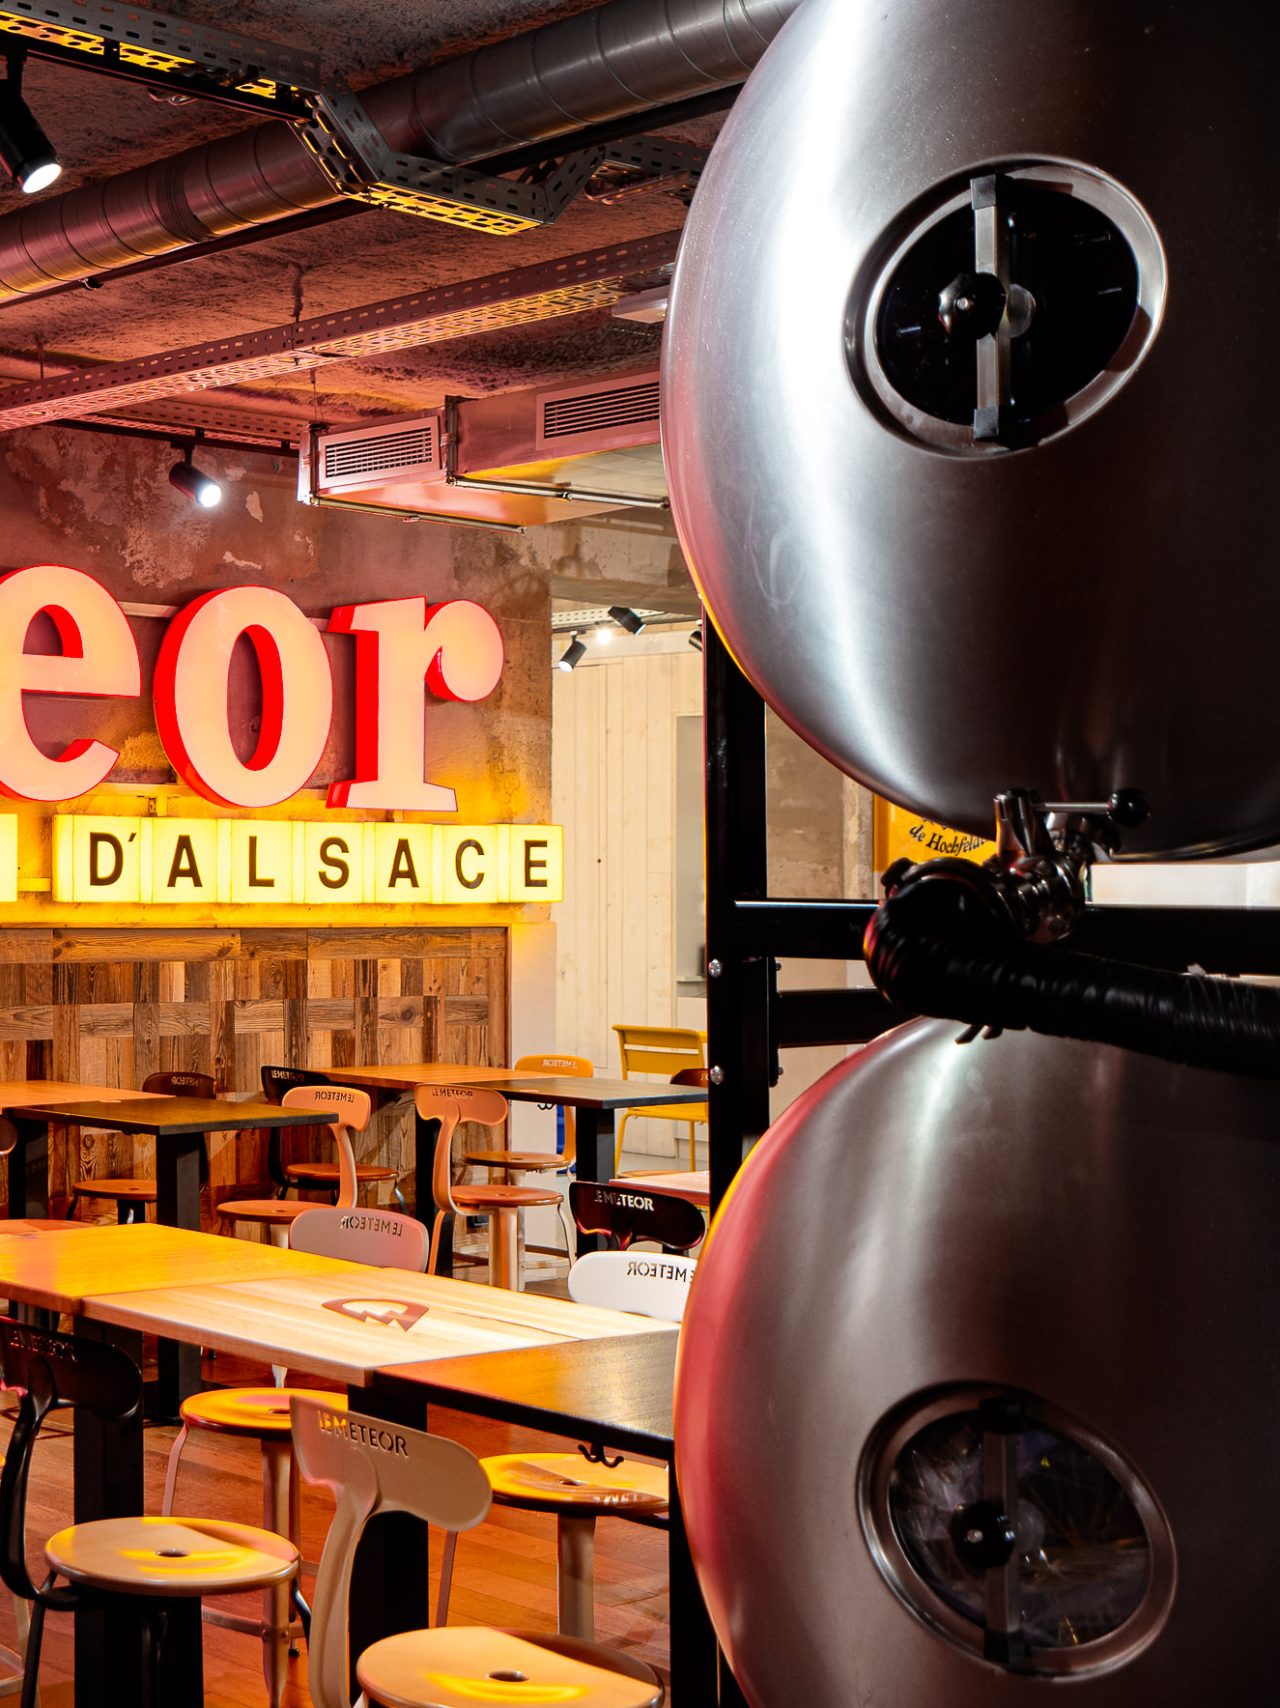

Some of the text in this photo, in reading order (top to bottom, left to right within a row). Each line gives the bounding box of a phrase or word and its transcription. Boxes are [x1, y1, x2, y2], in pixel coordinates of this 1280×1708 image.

[88, 831, 549, 891] D'ALSACE
[909, 824, 926, 842] de
[926, 832, 985, 856] Hochfeld
[333, 1415, 409, 1458] METEOR
